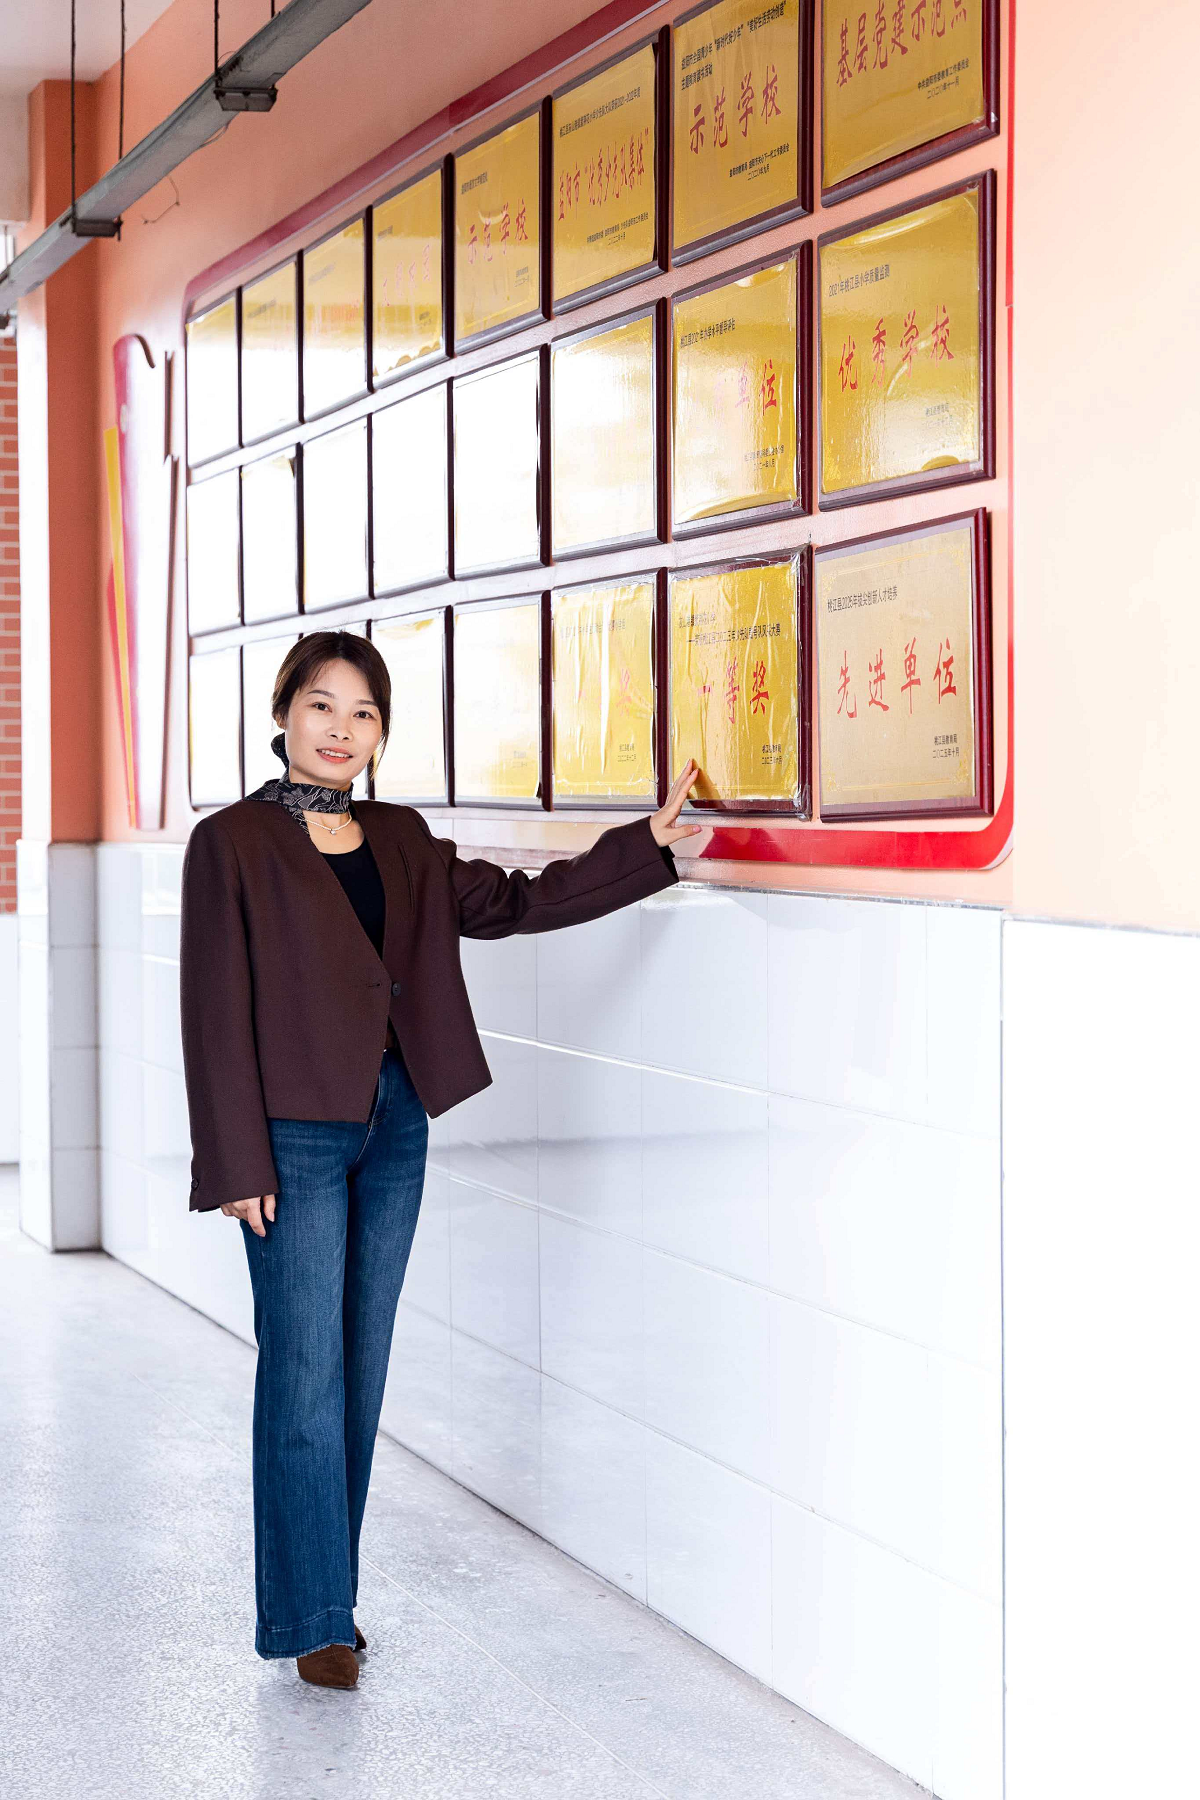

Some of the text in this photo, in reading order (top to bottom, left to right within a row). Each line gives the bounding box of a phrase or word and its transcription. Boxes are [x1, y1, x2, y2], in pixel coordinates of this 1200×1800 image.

[689, 64, 782, 155] 示范学校
[467, 197, 529, 264] 示范学校
[828, 264, 890, 298] 2021年桃江县小学质量监测
[837, 304, 955, 393] 优秀学校
[696, 656, 770, 725] 一等奖
[836, 636, 957, 719] 先进单位
